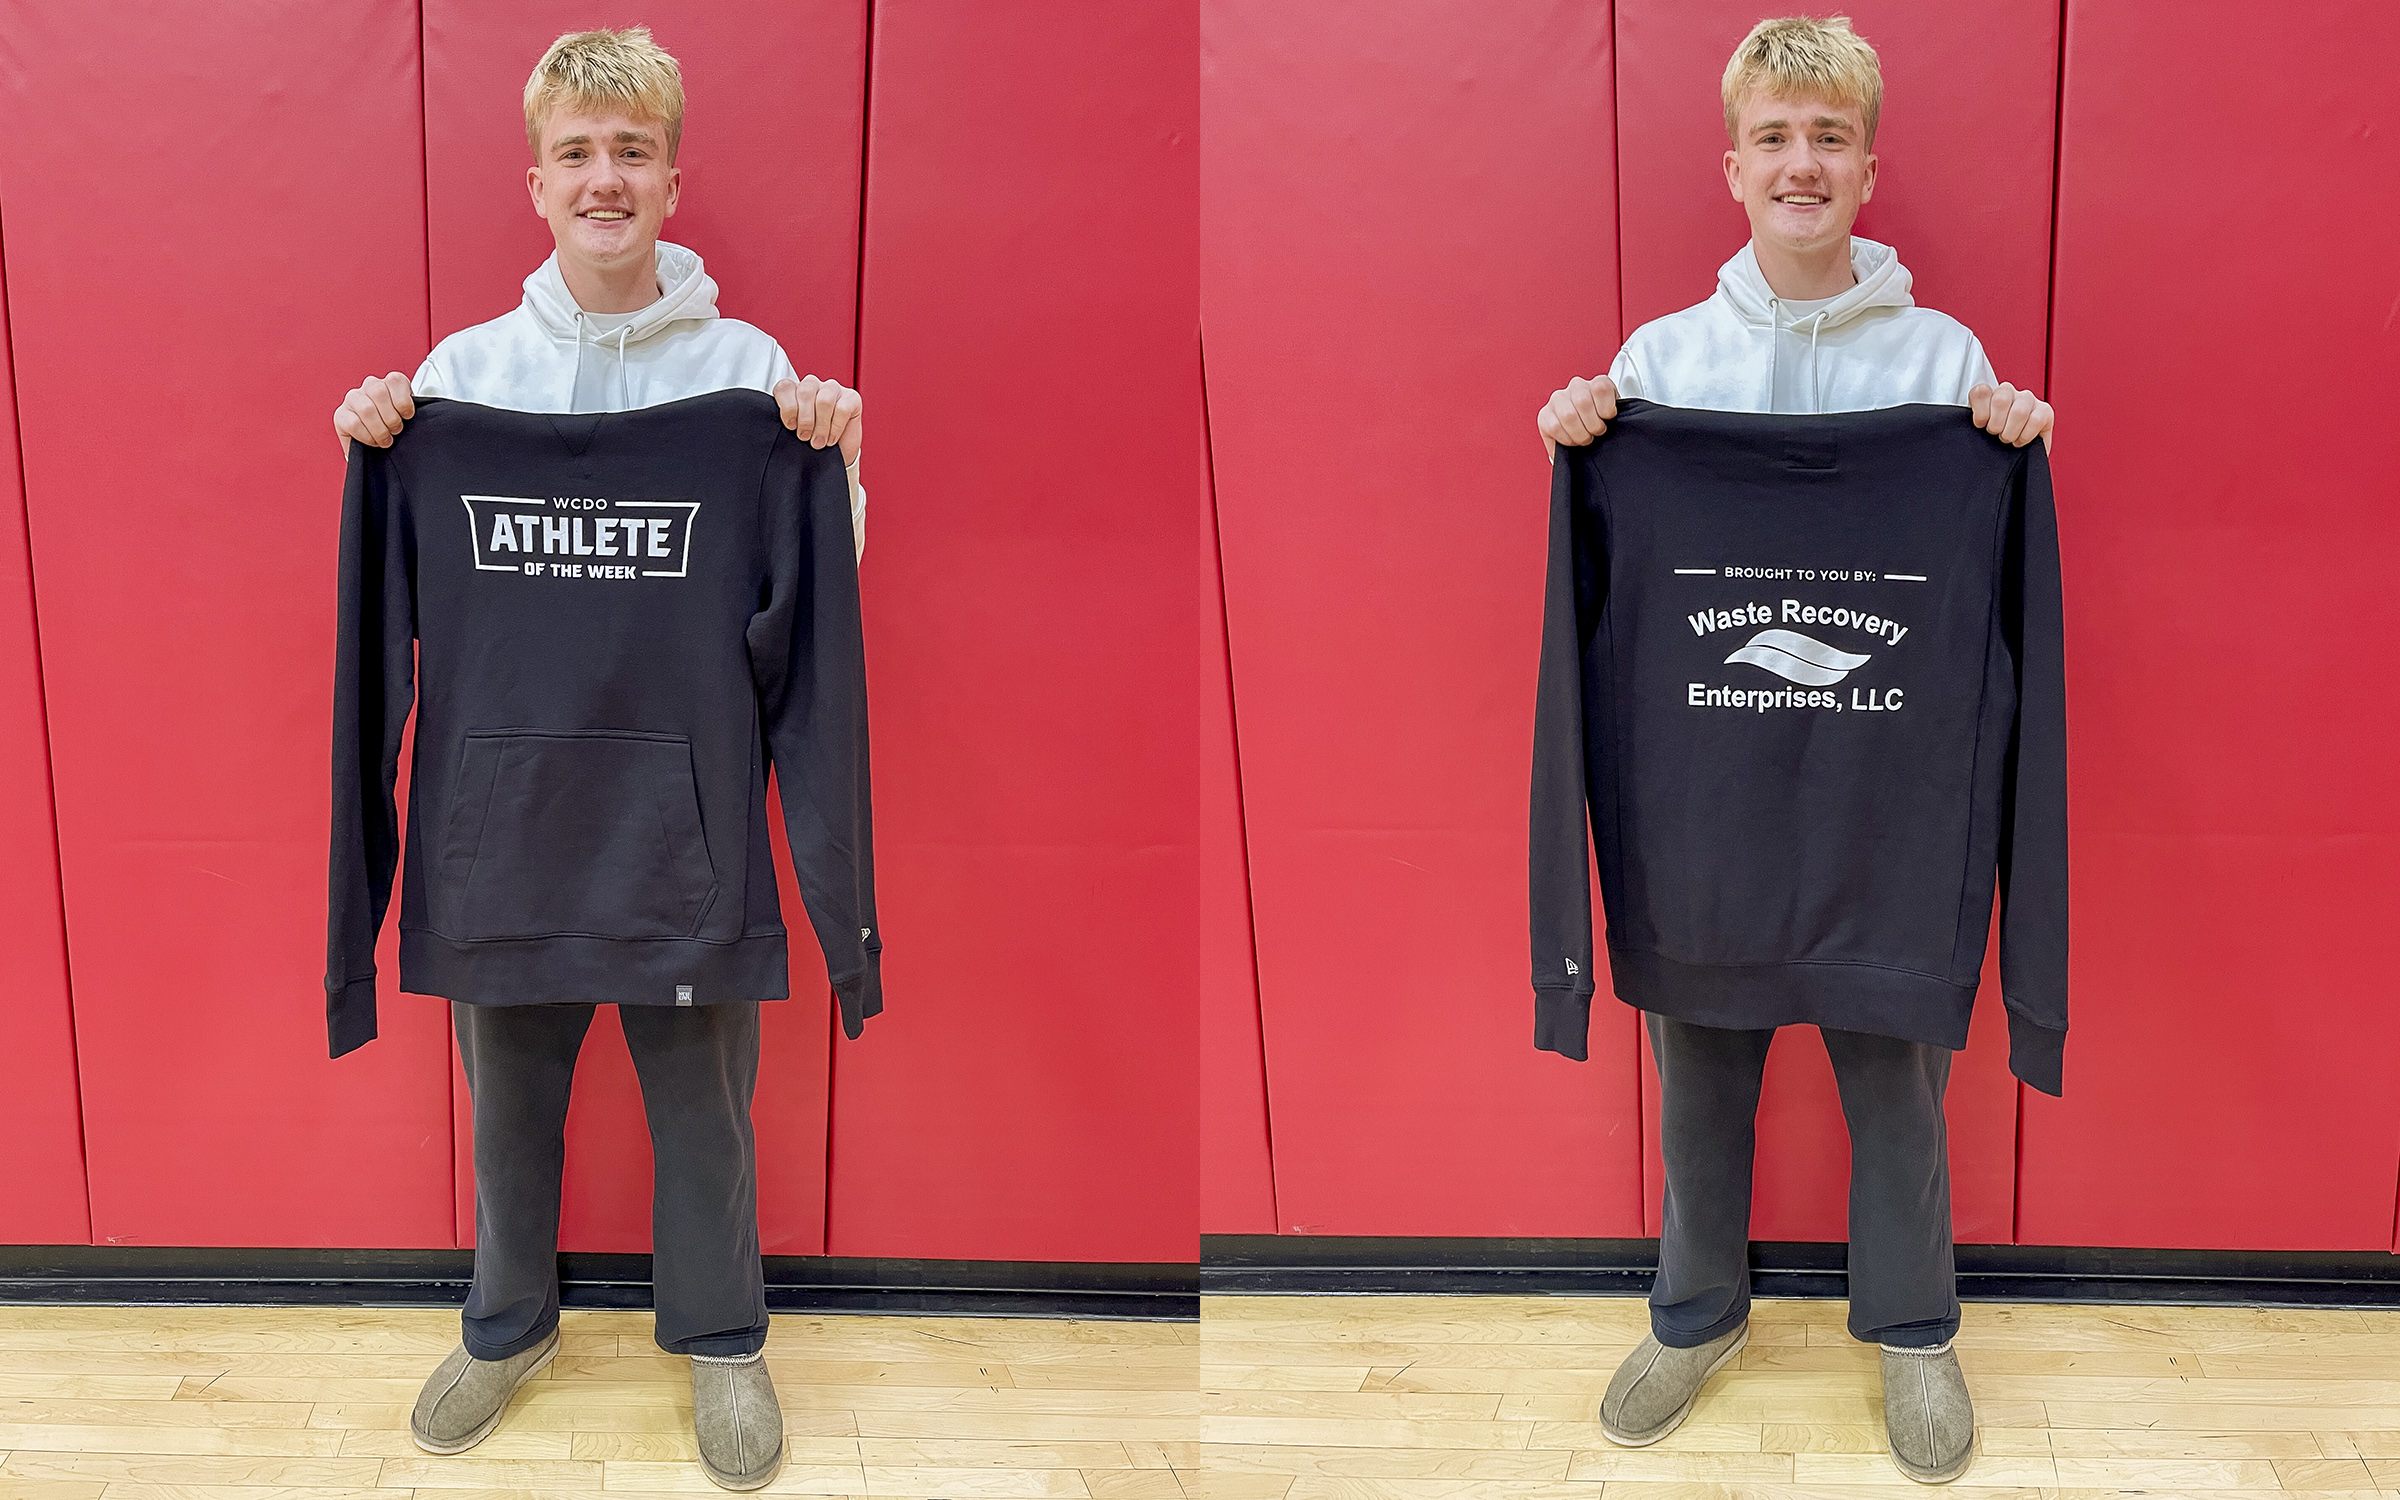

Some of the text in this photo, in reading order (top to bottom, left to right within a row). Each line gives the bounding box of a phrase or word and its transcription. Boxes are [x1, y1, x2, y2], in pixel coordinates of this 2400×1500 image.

[552, 497, 608, 511] WCDO
[489, 513, 673, 557] ATHLETE
[524, 561, 637, 580] OF THE WEEK
[1724, 566, 1876, 582] BROUGHT TO YOU BY:
[1687, 599, 1909, 646] Waste Recovery
[1688, 682, 1904, 713] Enterprises, LLC
